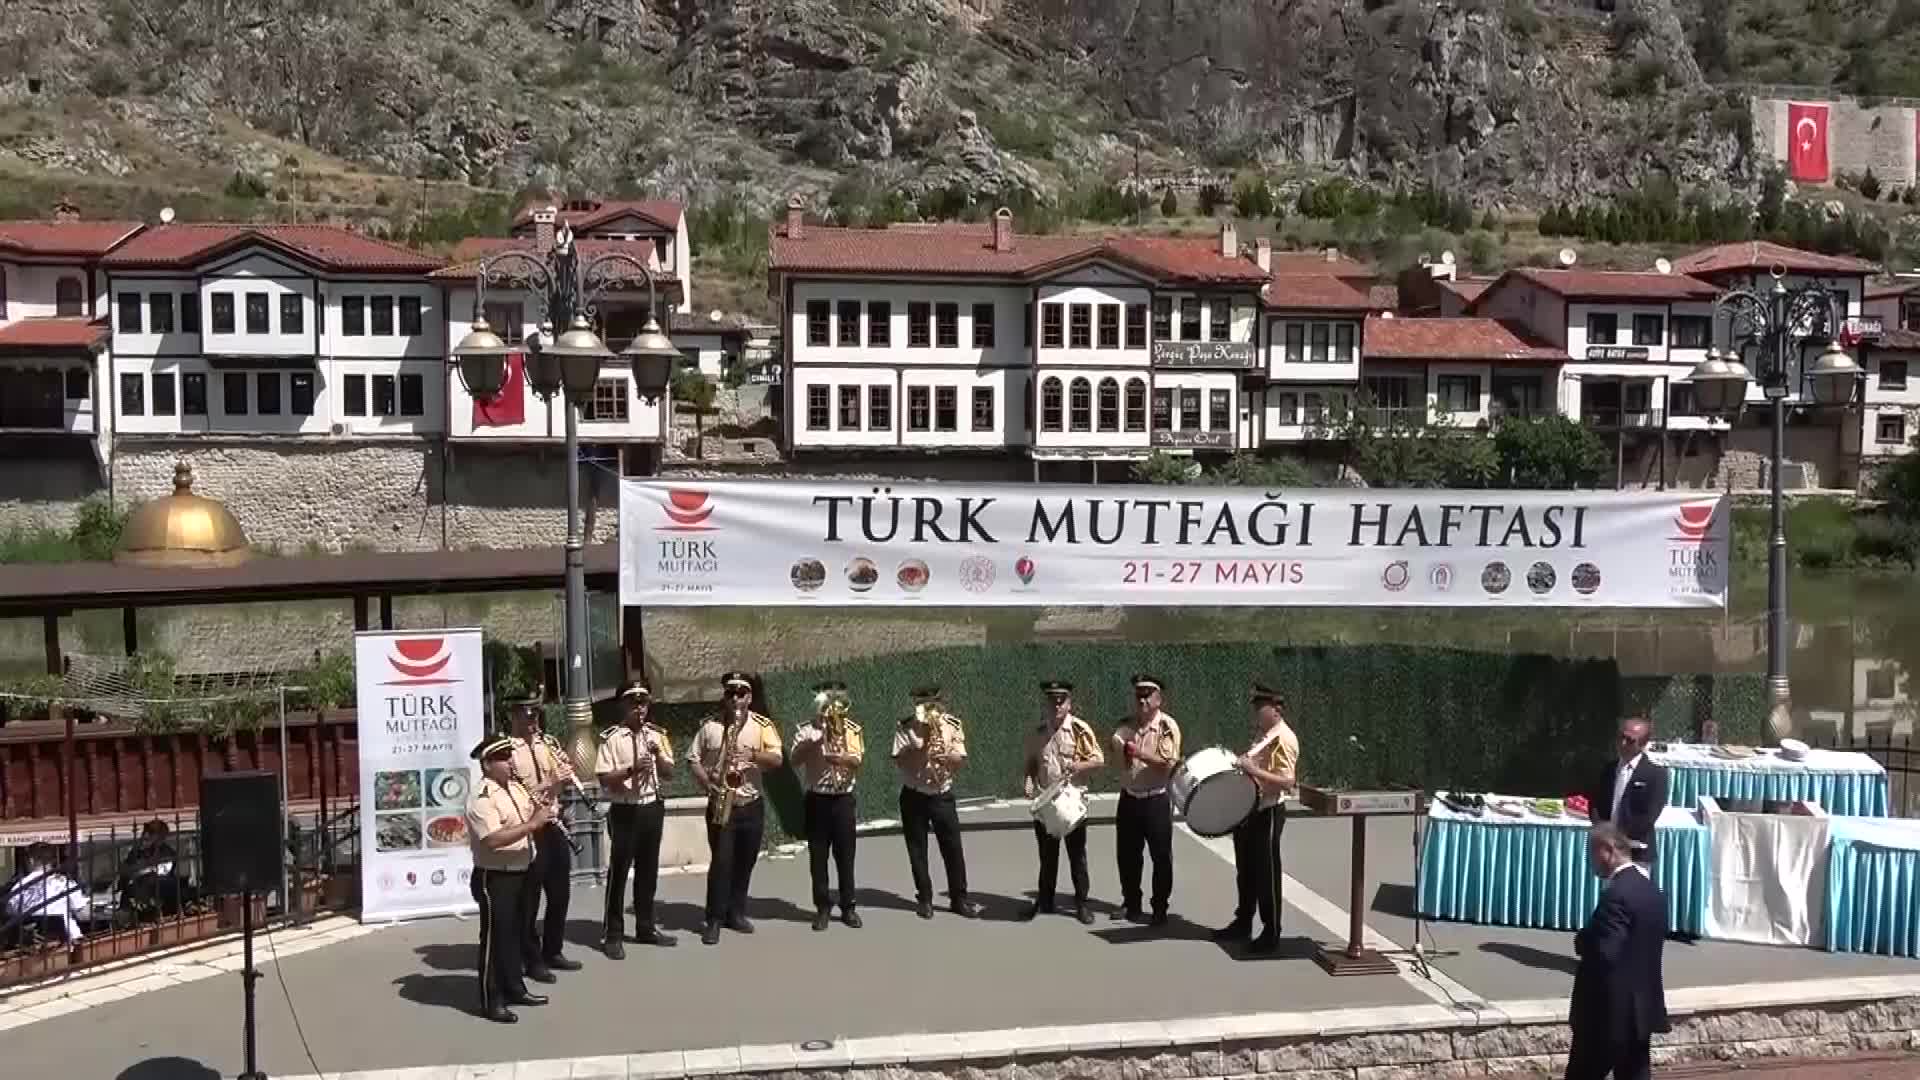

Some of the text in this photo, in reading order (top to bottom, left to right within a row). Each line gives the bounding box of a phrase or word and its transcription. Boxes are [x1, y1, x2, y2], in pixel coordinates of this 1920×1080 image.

[813, 486, 1590, 548] TÜRK MUTFAĞI HAFTASI
[658, 537, 718, 559] TÜRK
[1122, 561, 1305, 585] 21-27 MAYIS
[384, 693, 457, 718] TÜRK
